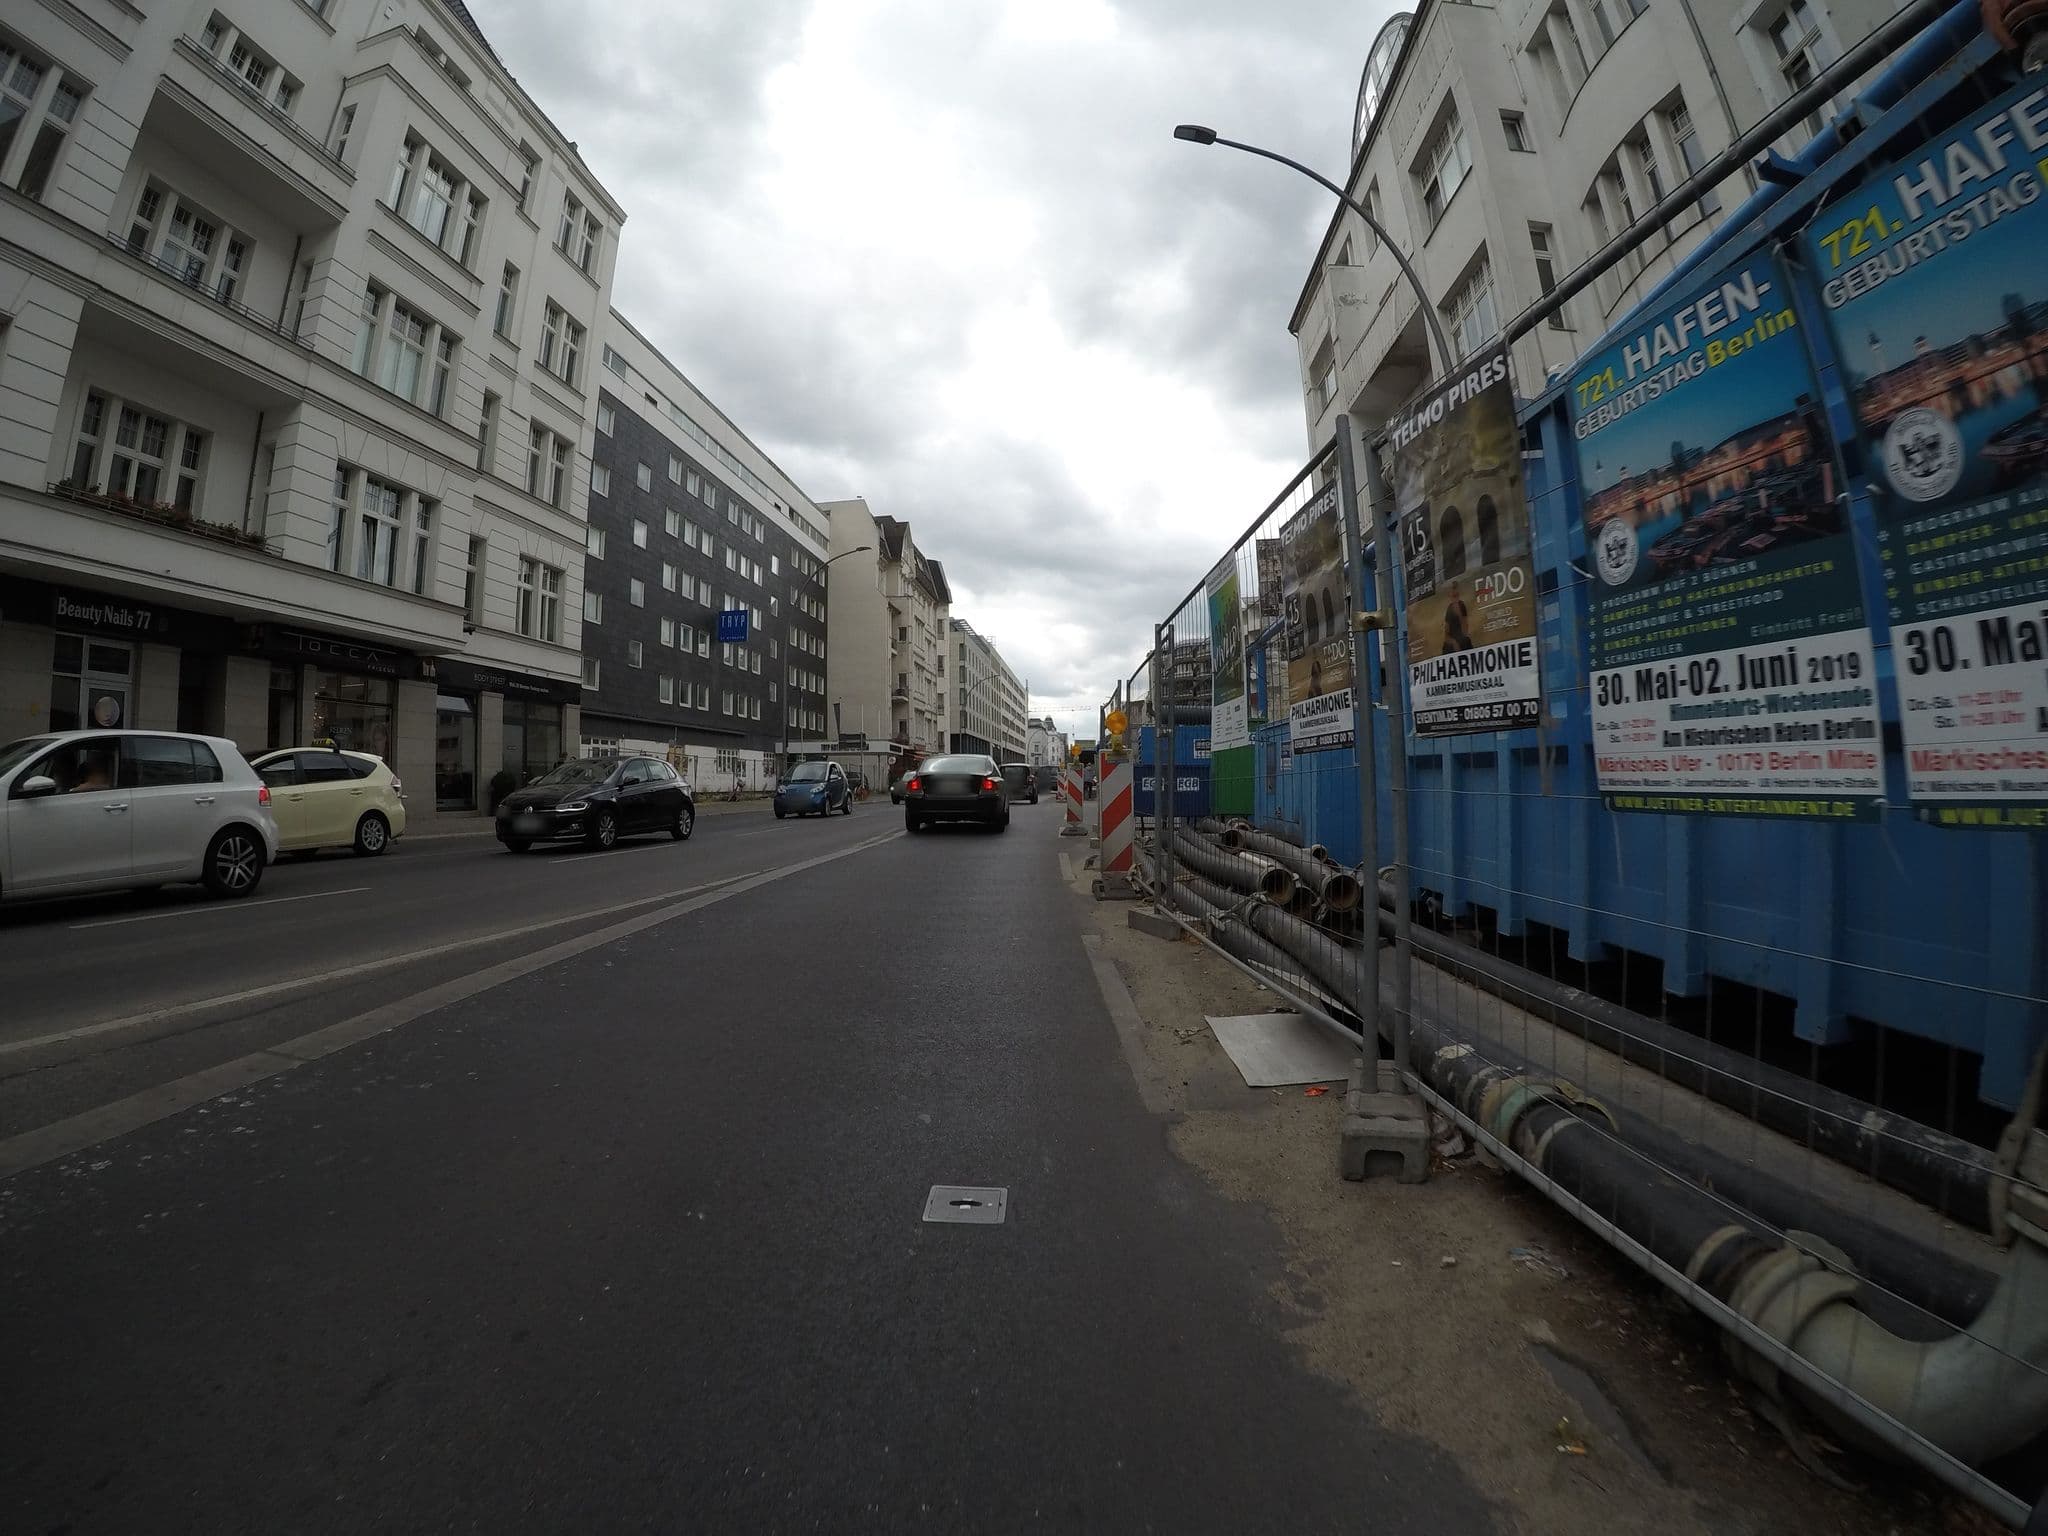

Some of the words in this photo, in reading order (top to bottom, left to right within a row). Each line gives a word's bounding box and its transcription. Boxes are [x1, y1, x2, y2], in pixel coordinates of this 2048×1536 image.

[1819, 202, 1905, 269] 721.
[1822, 169, 2042, 310] GEBURTSTAG
[1576, 365, 1624, 410] 721.
[1622, 269, 1772, 382] HAFEN-
[1574, 350, 1706, 440] GEBURTSTAG
[1705, 308, 1797, 368] Berlin
[1392, 396, 1444, 452] TELMO
[1448, 354, 1507, 412] PIRES
[1280, 513, 1308, 548] TELMO
[1309, 486, 1337, 524] PIRES
[1407, 515, 1426, 556] 15
[1474, 566, 1525, 604] FADO
[57, 596, 104, 624] Beauty
[103, 604, 135, 628] Nails
[136, 610, 152, 630] 77
[720, 614, 746, 628] TRYP
[1287, 598, 1300, 625] 15
[1413, 641, 1533, 686] PHILHARMONIE
[1904, 625, 1970, 675] 30.
[1425, 675, 1505, 698] KAMMERMUSIKSAAL
[1597, 673, 1630, 706] 30.
[1635, 657, 1730, 702] Mai-02.
[1737, 646, 1798, 691] Juni
[1807, 651, 1862, 683] 2019
[1292, 691, 1351, 721] PHILHARMONIE
[1463, 706, 1491, 721] 01806
[1492, 704, 1504, 718] 57
[1506, 704, 1521, 717] 00
[1522, 701, 1538, 715] 70
[1663, 730, 1682, 748] Am
[1774, 722, 1819, 742] Hafen
[1823, 717, 1876, 741] Berlin
[1598, 756, 1668, 772] Märkisches
[1671, 754, 1702, 771] Ufer
[1717, 752, 1764, 771] 10179
[1769, 750, 1823, 770] Berlin
[1827, 749, 1879, 770] Mitte
